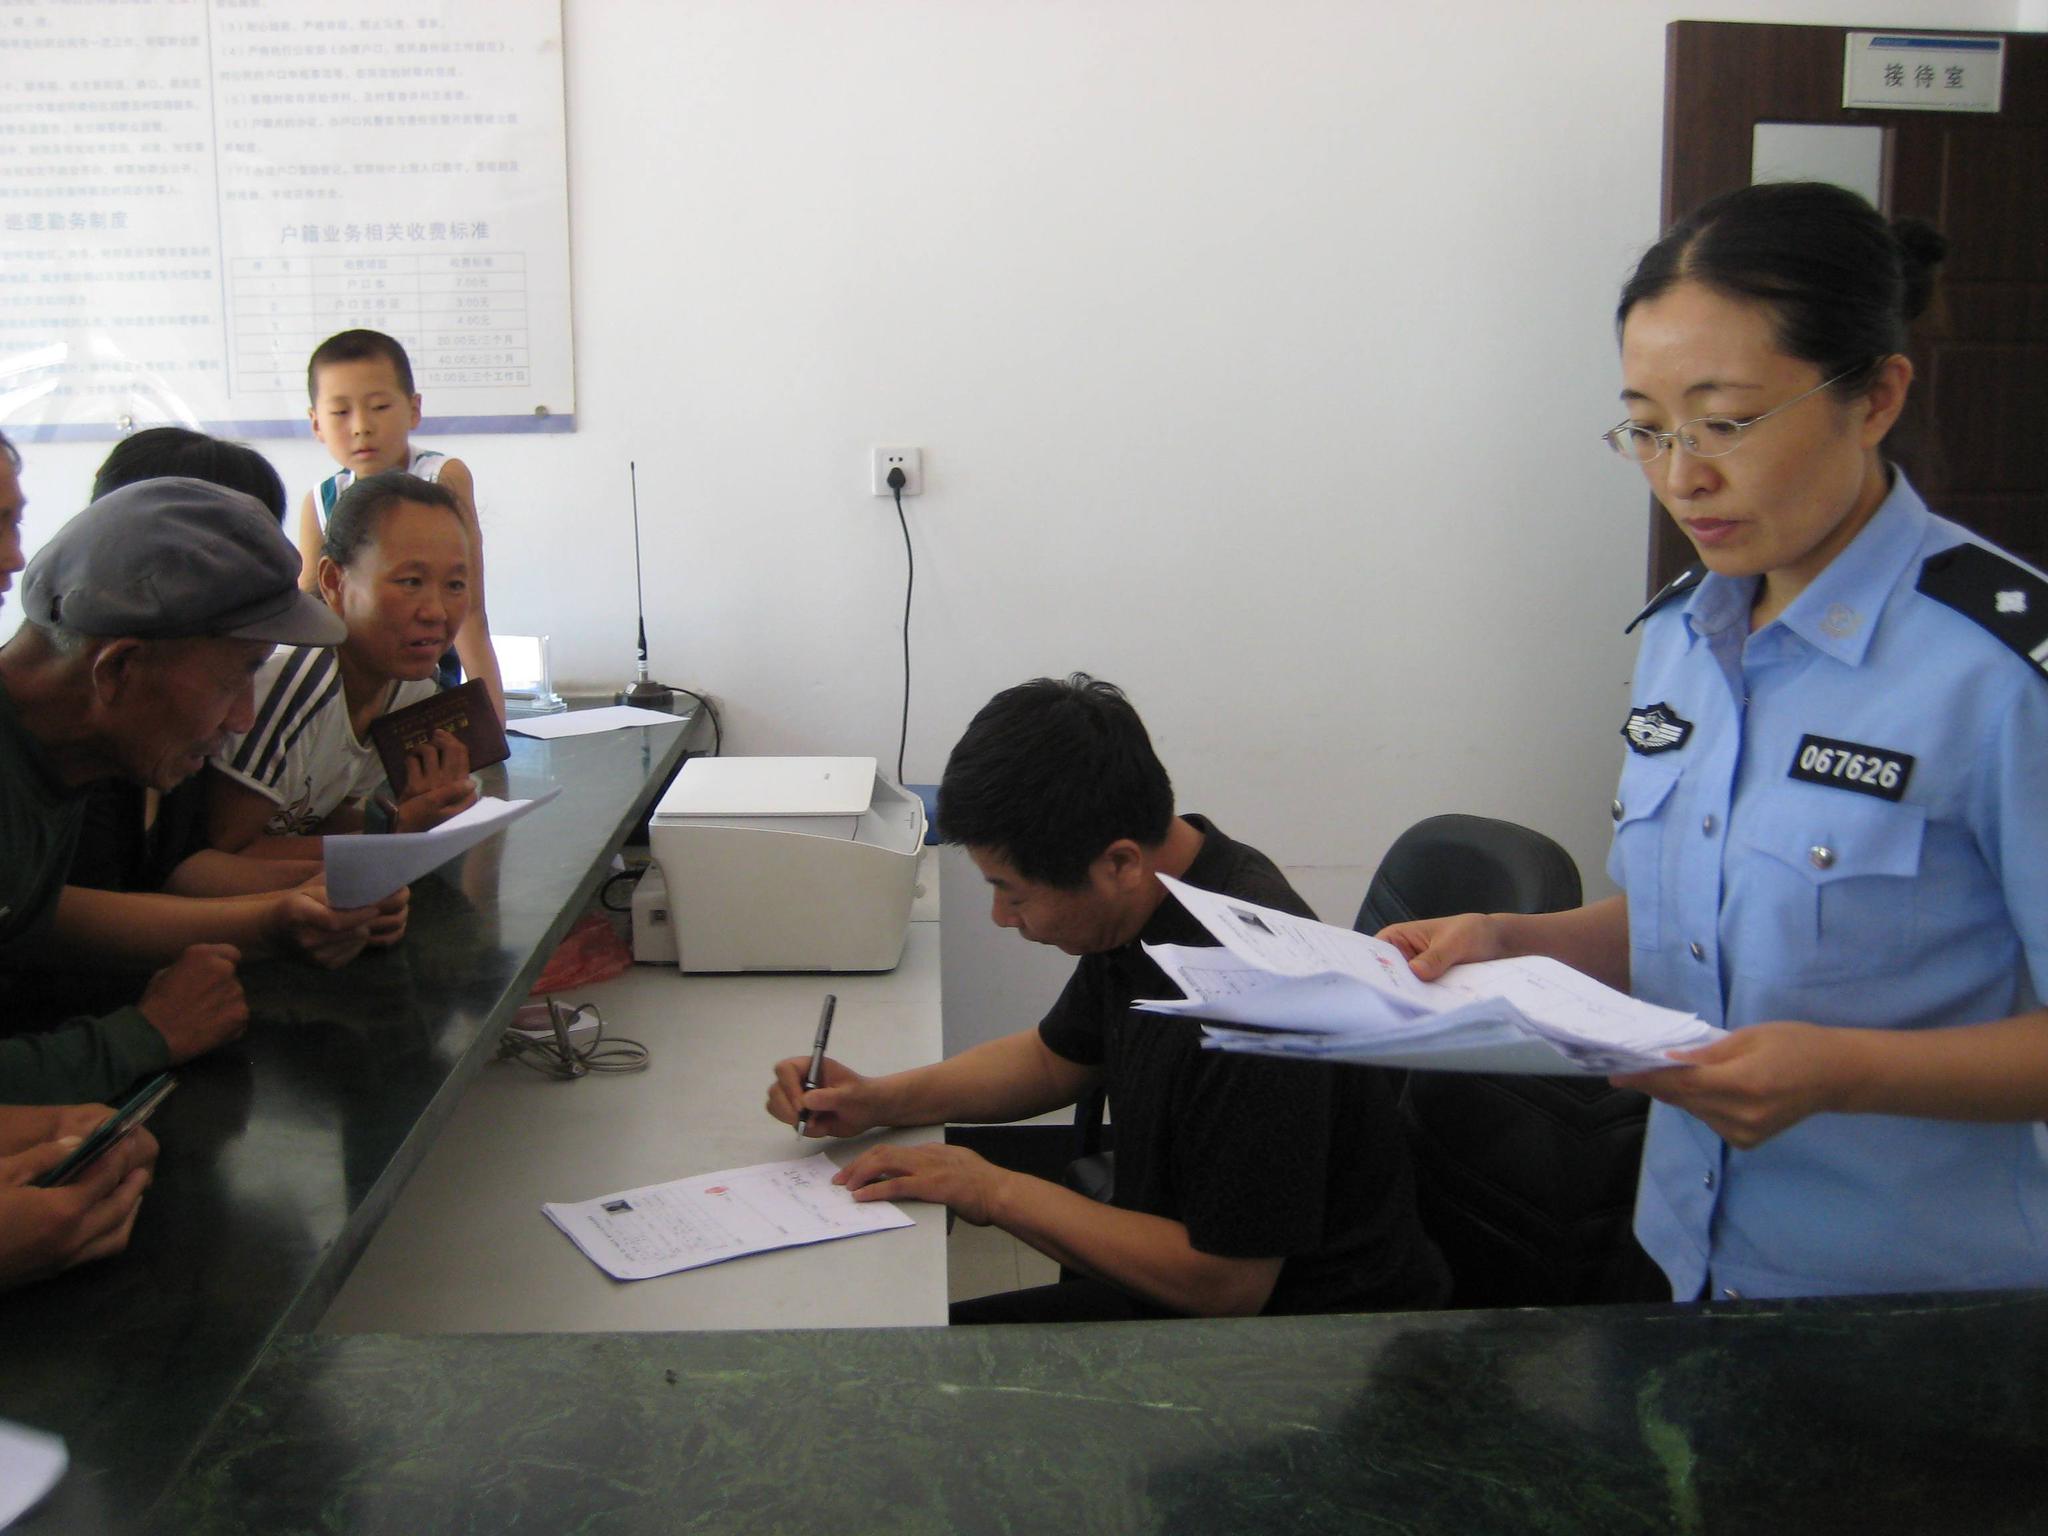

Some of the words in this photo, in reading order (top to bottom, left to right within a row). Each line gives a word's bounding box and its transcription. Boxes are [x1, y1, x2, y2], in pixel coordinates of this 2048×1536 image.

[1884, 61, 1965, 89] 接待室
[281, 221, 489, 244] 户籍业务相关收费标准
[1800, 744, 1902, 789] 067626
